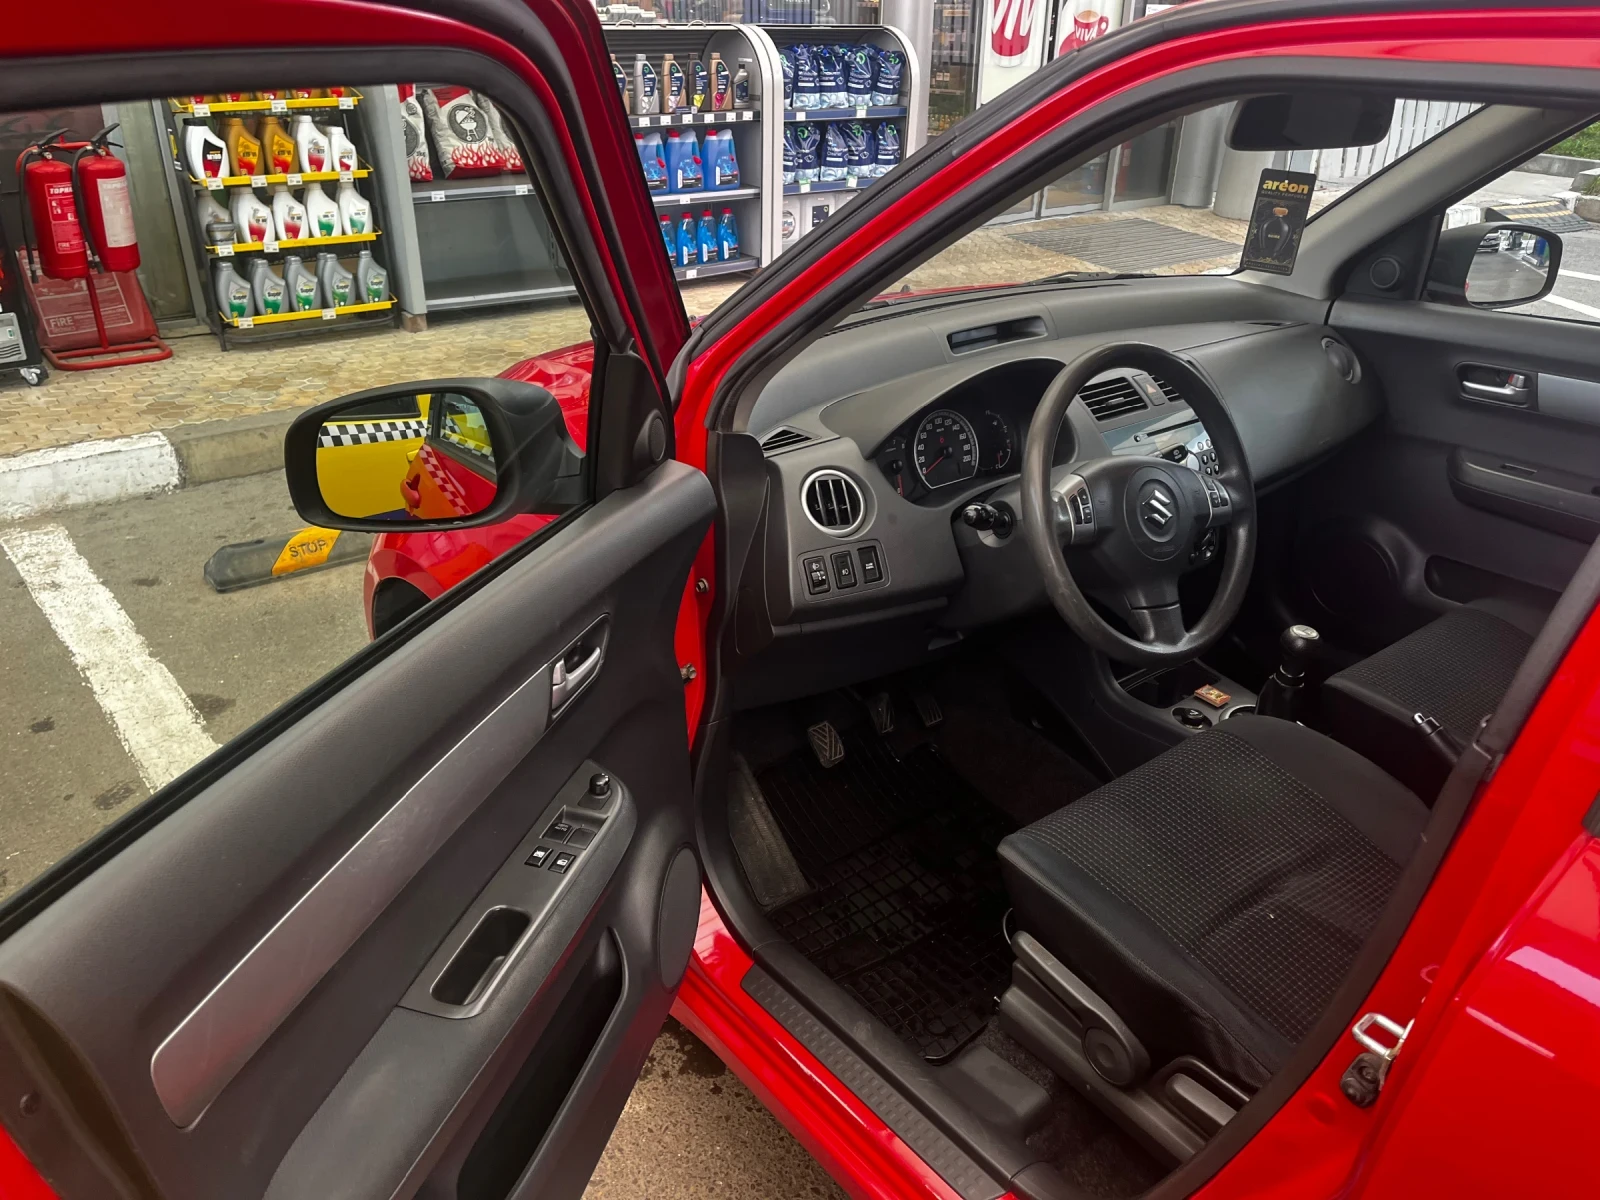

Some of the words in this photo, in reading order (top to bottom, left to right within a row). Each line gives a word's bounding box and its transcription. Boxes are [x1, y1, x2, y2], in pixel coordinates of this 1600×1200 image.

[1075, 24, 1098, 41] VIVA
[50, 316, 74, 328] FIRE
[289, 538, 326, 557] STOP
